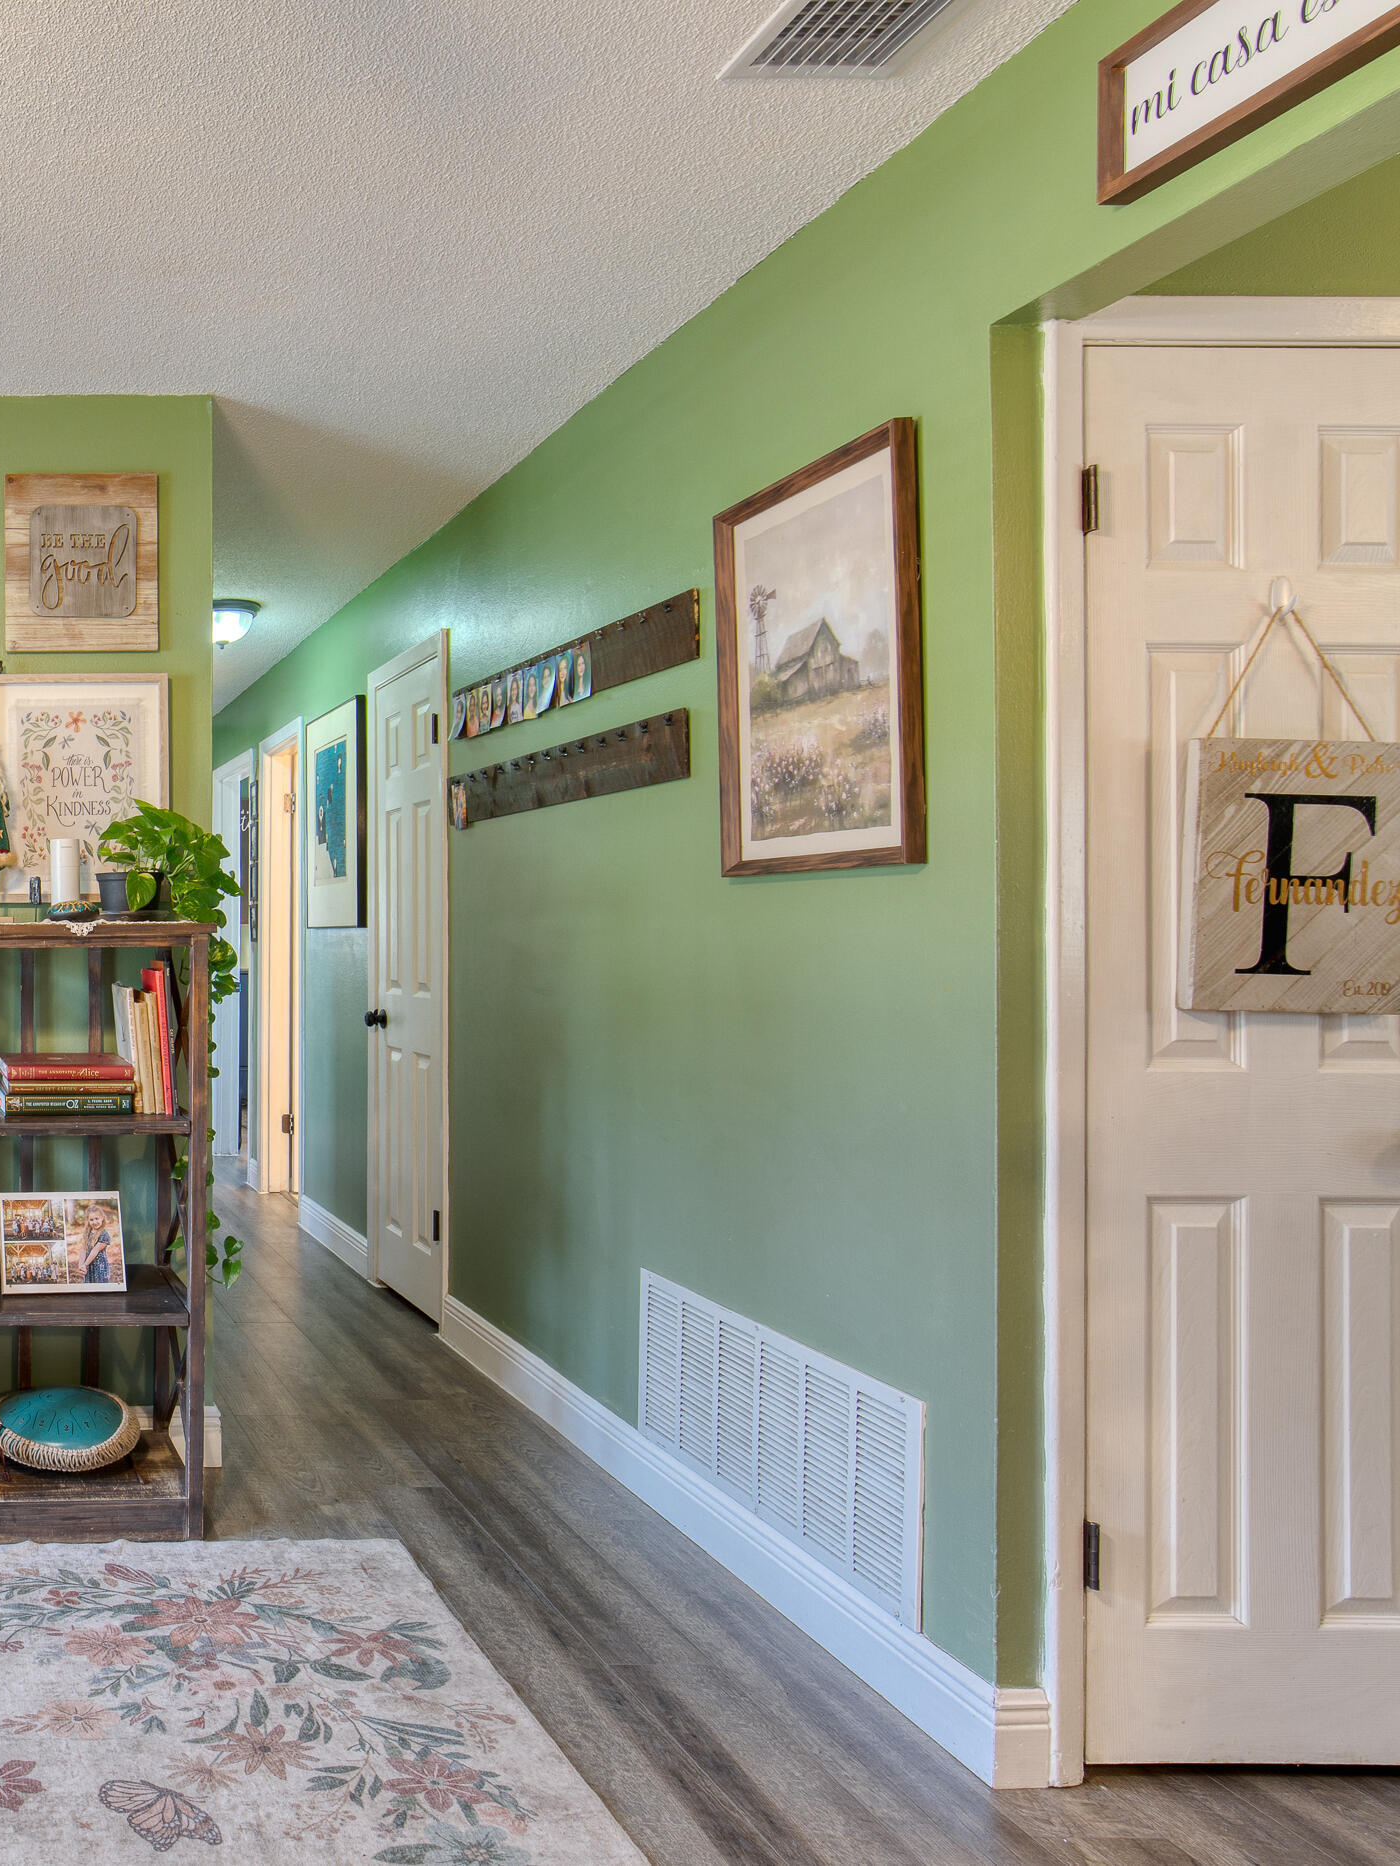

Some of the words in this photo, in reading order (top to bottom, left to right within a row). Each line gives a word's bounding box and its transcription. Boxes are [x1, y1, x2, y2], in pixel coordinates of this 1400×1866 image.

[1131, 67, 1182, 135] mi
[1191, 9, 1289, 95] casa
[40, 533, 64, 549] BE
[69, 533, 106, 549] THE
[40, 523, 129, 610] good
[1304, 743, 1339, 779] &
[51, 766, 111, 793] POWER
[72, 788, 83, 799] in
[46, 795, 111, 827] KINDNESS
[1235, 792, 1377, 976] F
[66, 1099, 79, 1109] OZ
